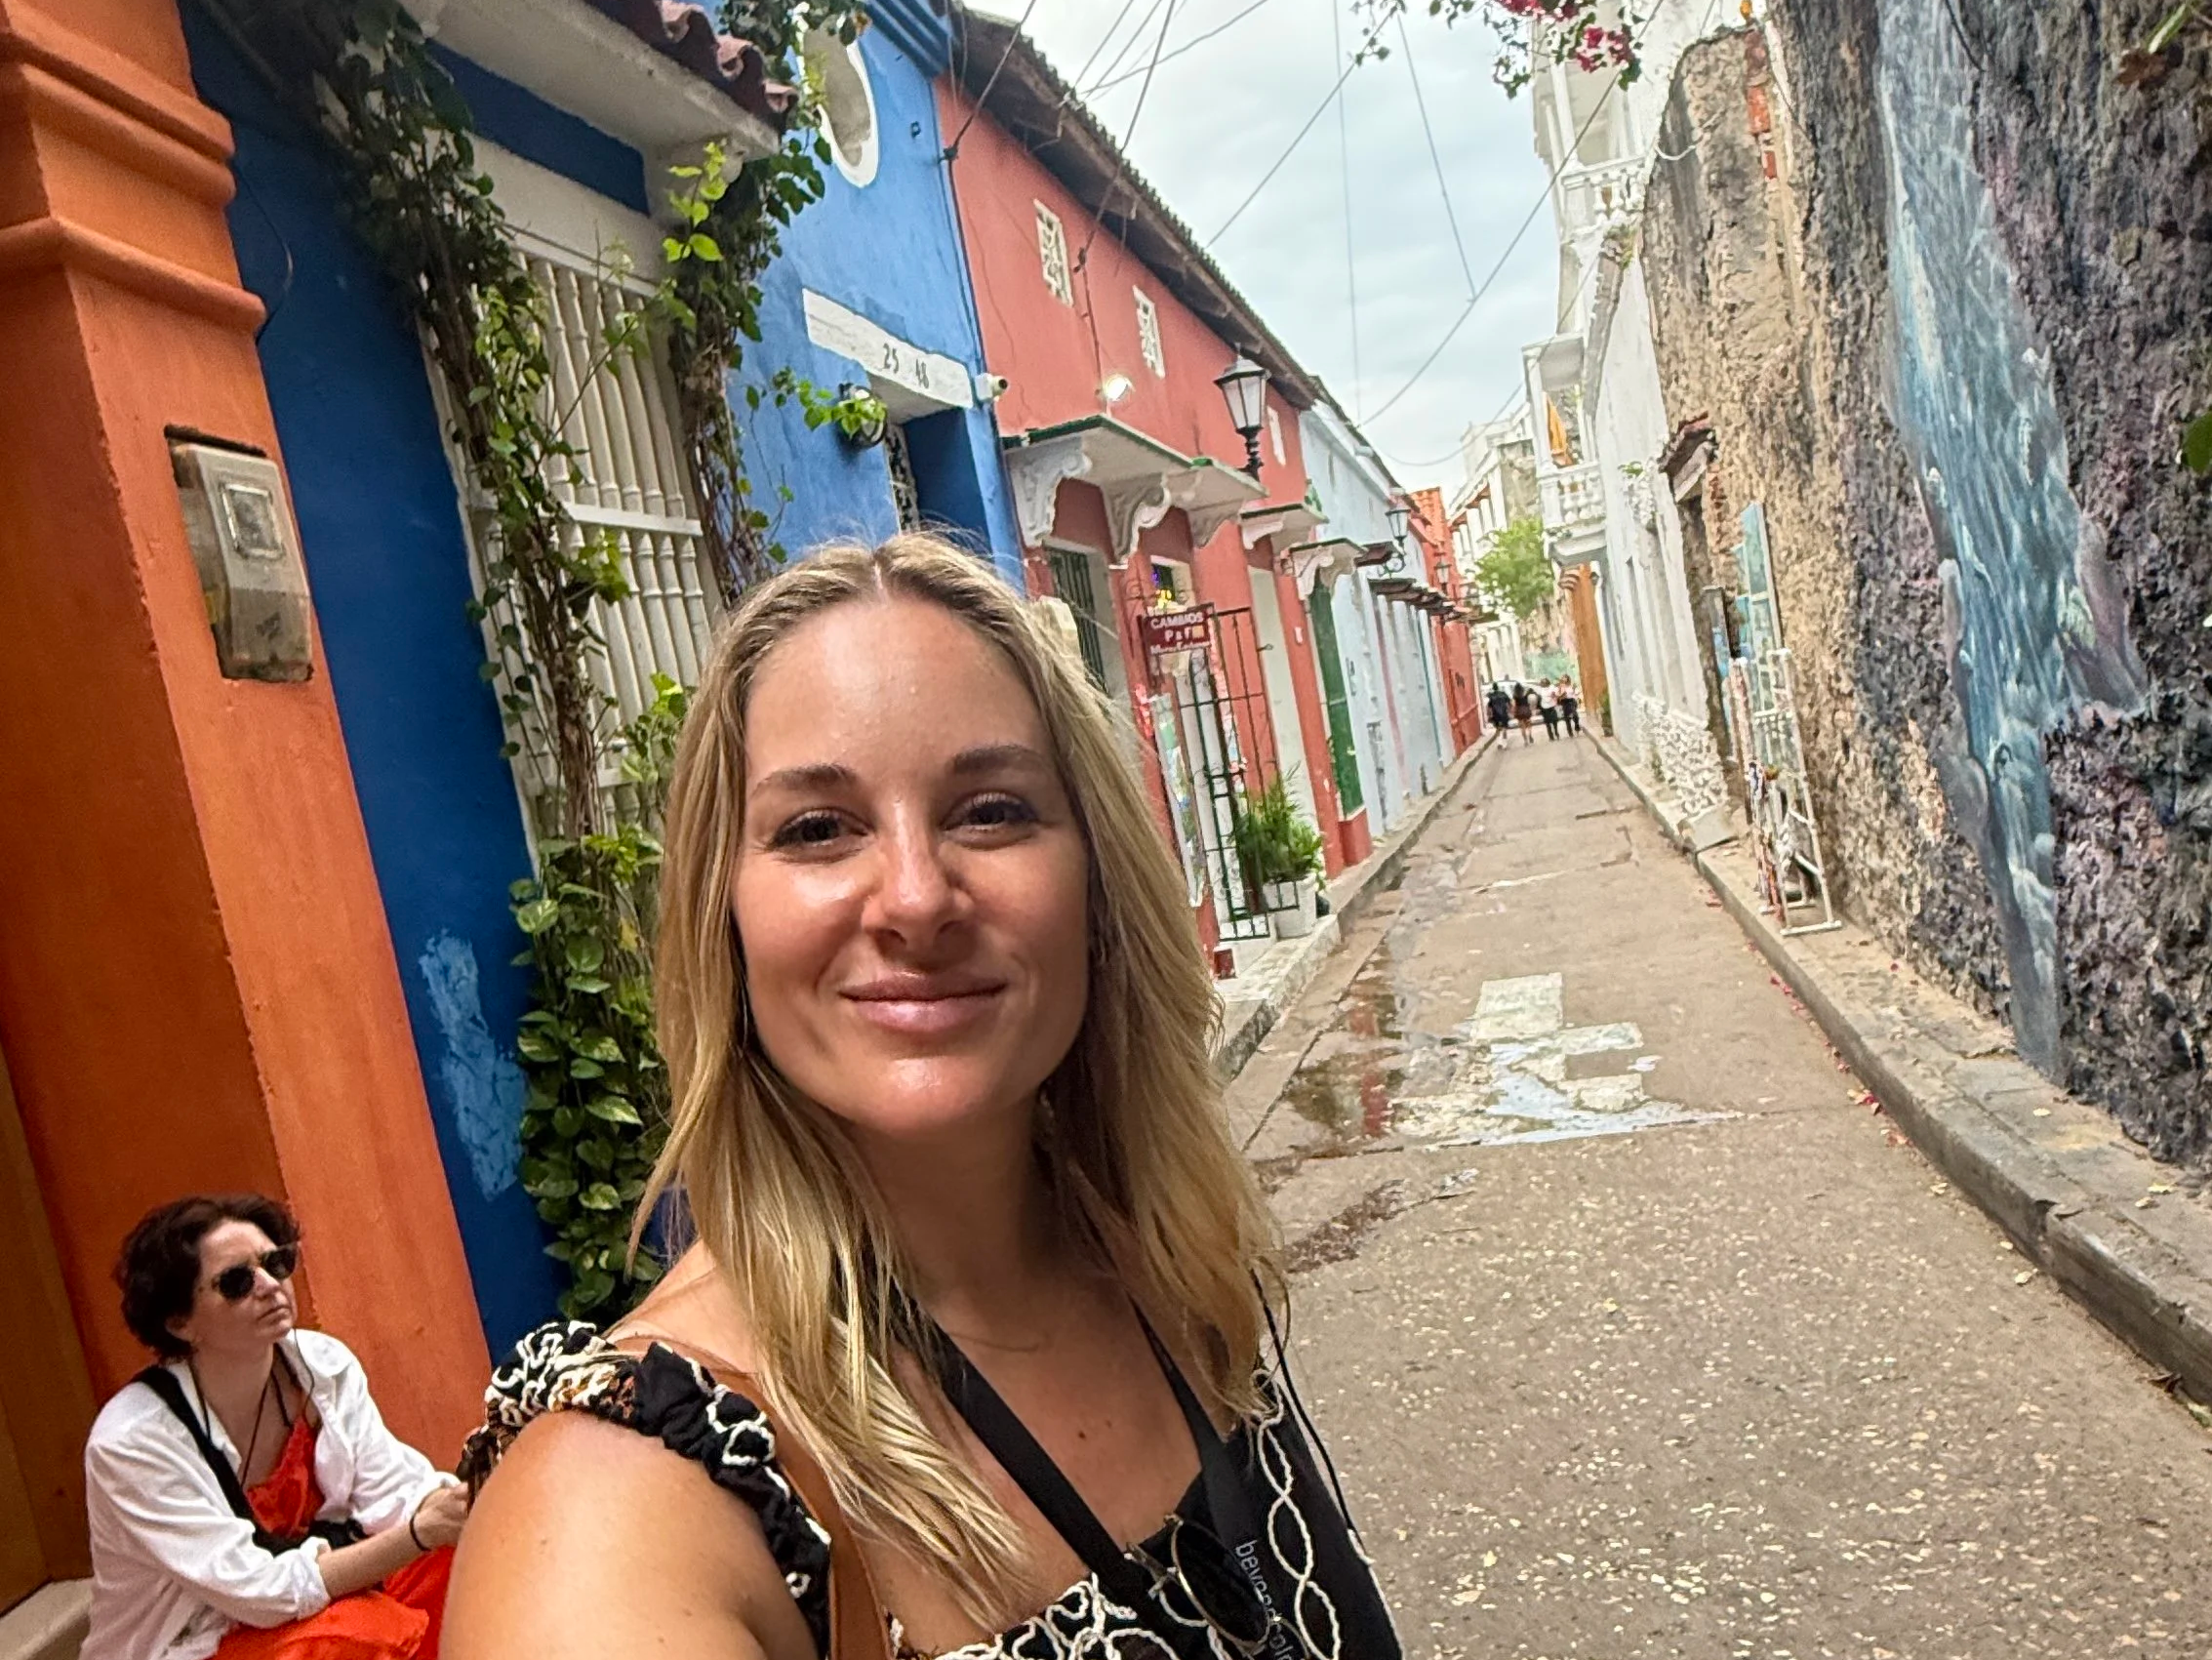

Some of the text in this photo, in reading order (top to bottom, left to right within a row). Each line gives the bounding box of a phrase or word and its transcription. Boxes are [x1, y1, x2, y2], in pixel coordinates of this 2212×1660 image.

[882, 343, 899, 374] 25
[1150, 611, 1204, 629] CAMBIOS
[1165, 628, 1174, 642] P
